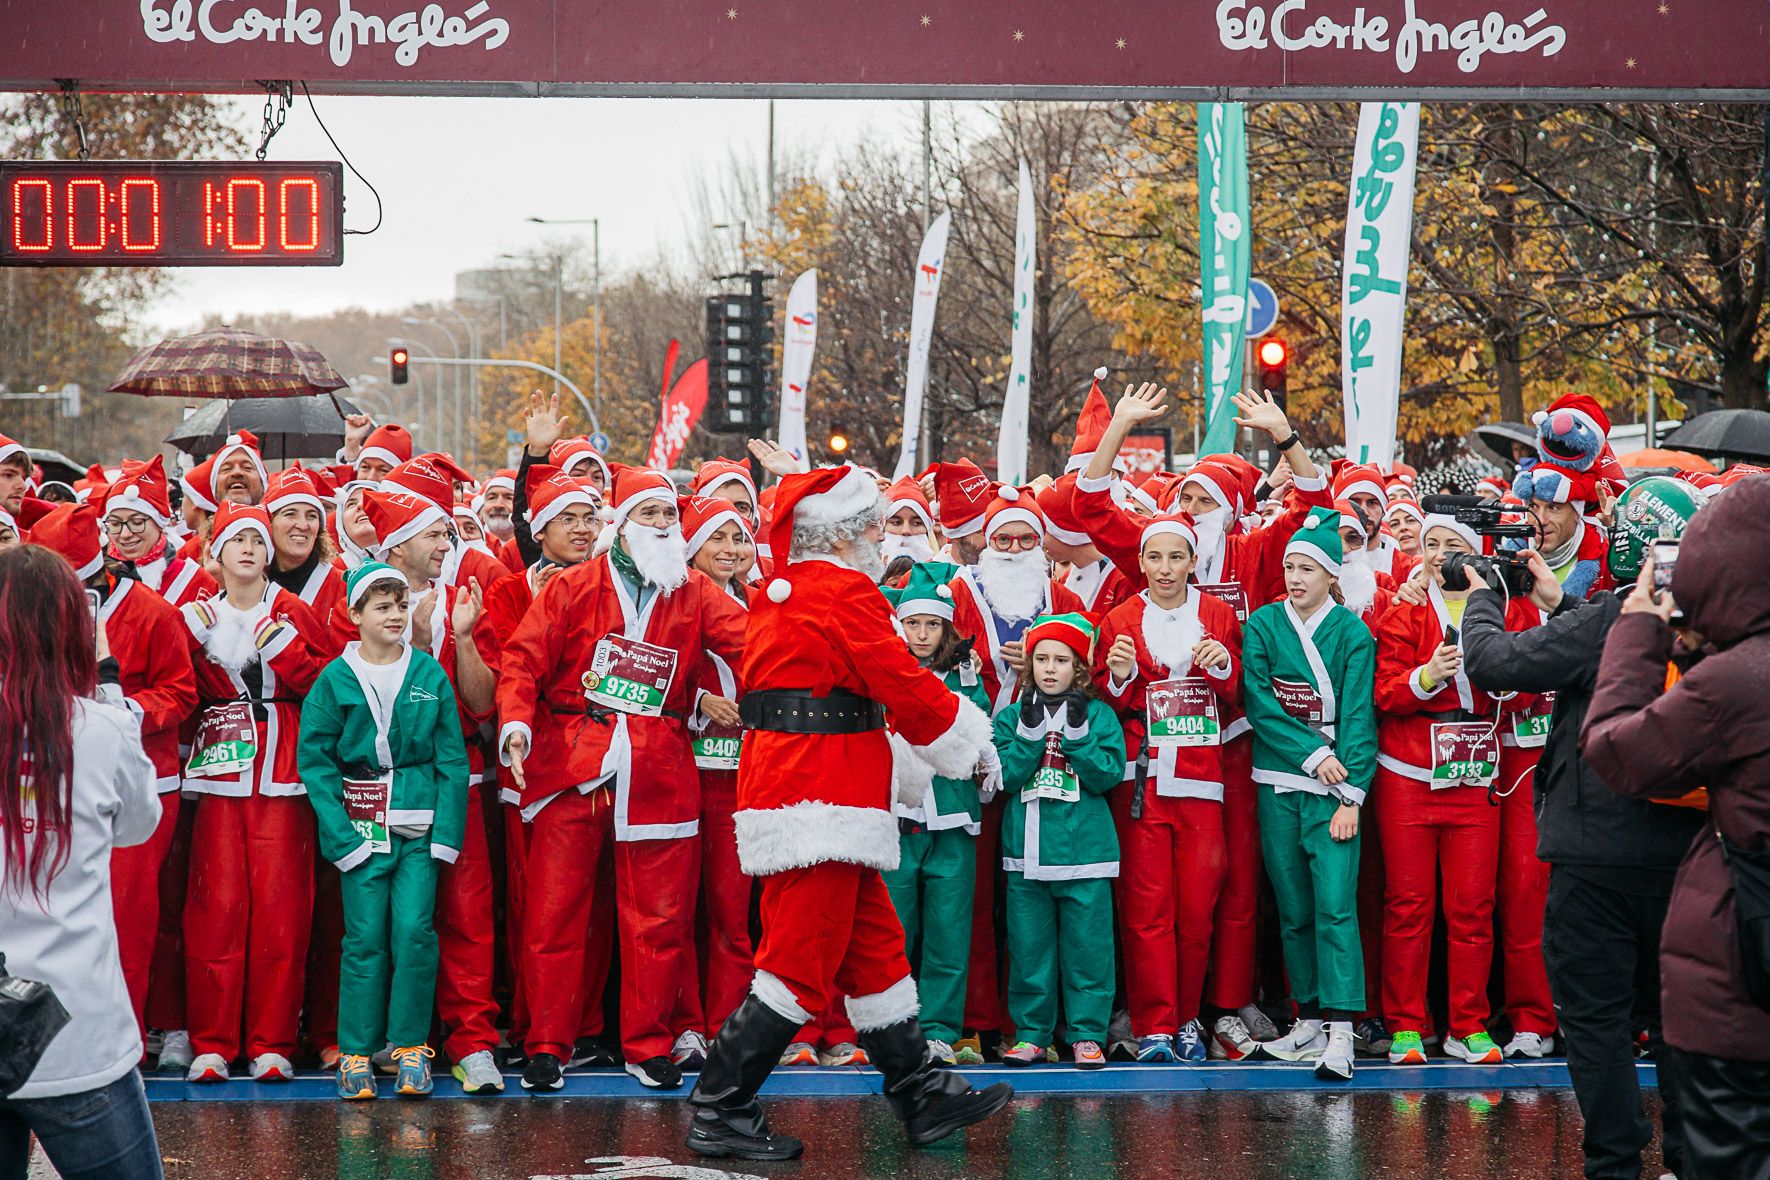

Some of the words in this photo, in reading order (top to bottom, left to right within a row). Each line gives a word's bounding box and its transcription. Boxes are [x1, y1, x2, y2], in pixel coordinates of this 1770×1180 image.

[140, 0, 195, 42] El
[197, 0, 323, 45] Corte
[329, 0, 510, 67] Inglés
[1215, 0, 1268, 50] El
[1270, 0, 1390, 52] Corte
[1395, 0, 1566, 73] Inglés
[1636, 490, 1688, 531] ELEMENT
[1223, 592, 1240, 601] Noel
[596, 647, 607, 668] 1003
[627, 649, 648, 663] Papá
[649, 656, 669, 668] Noel
[605, 677, 650, 703] 9735
[1173, 688, 1194, 697] Papá
[1195, 687, 1210, 696] Noel
[1166, 717, 1205, 735] 9404
[703, 738, 739, 757] 9409
[1461, 733, 1478, 743] Papá
[201, 742, 238, 766] 2961
[1448, 762, 1484, 779] 3133
[363, 793, 383, 801] Noel
